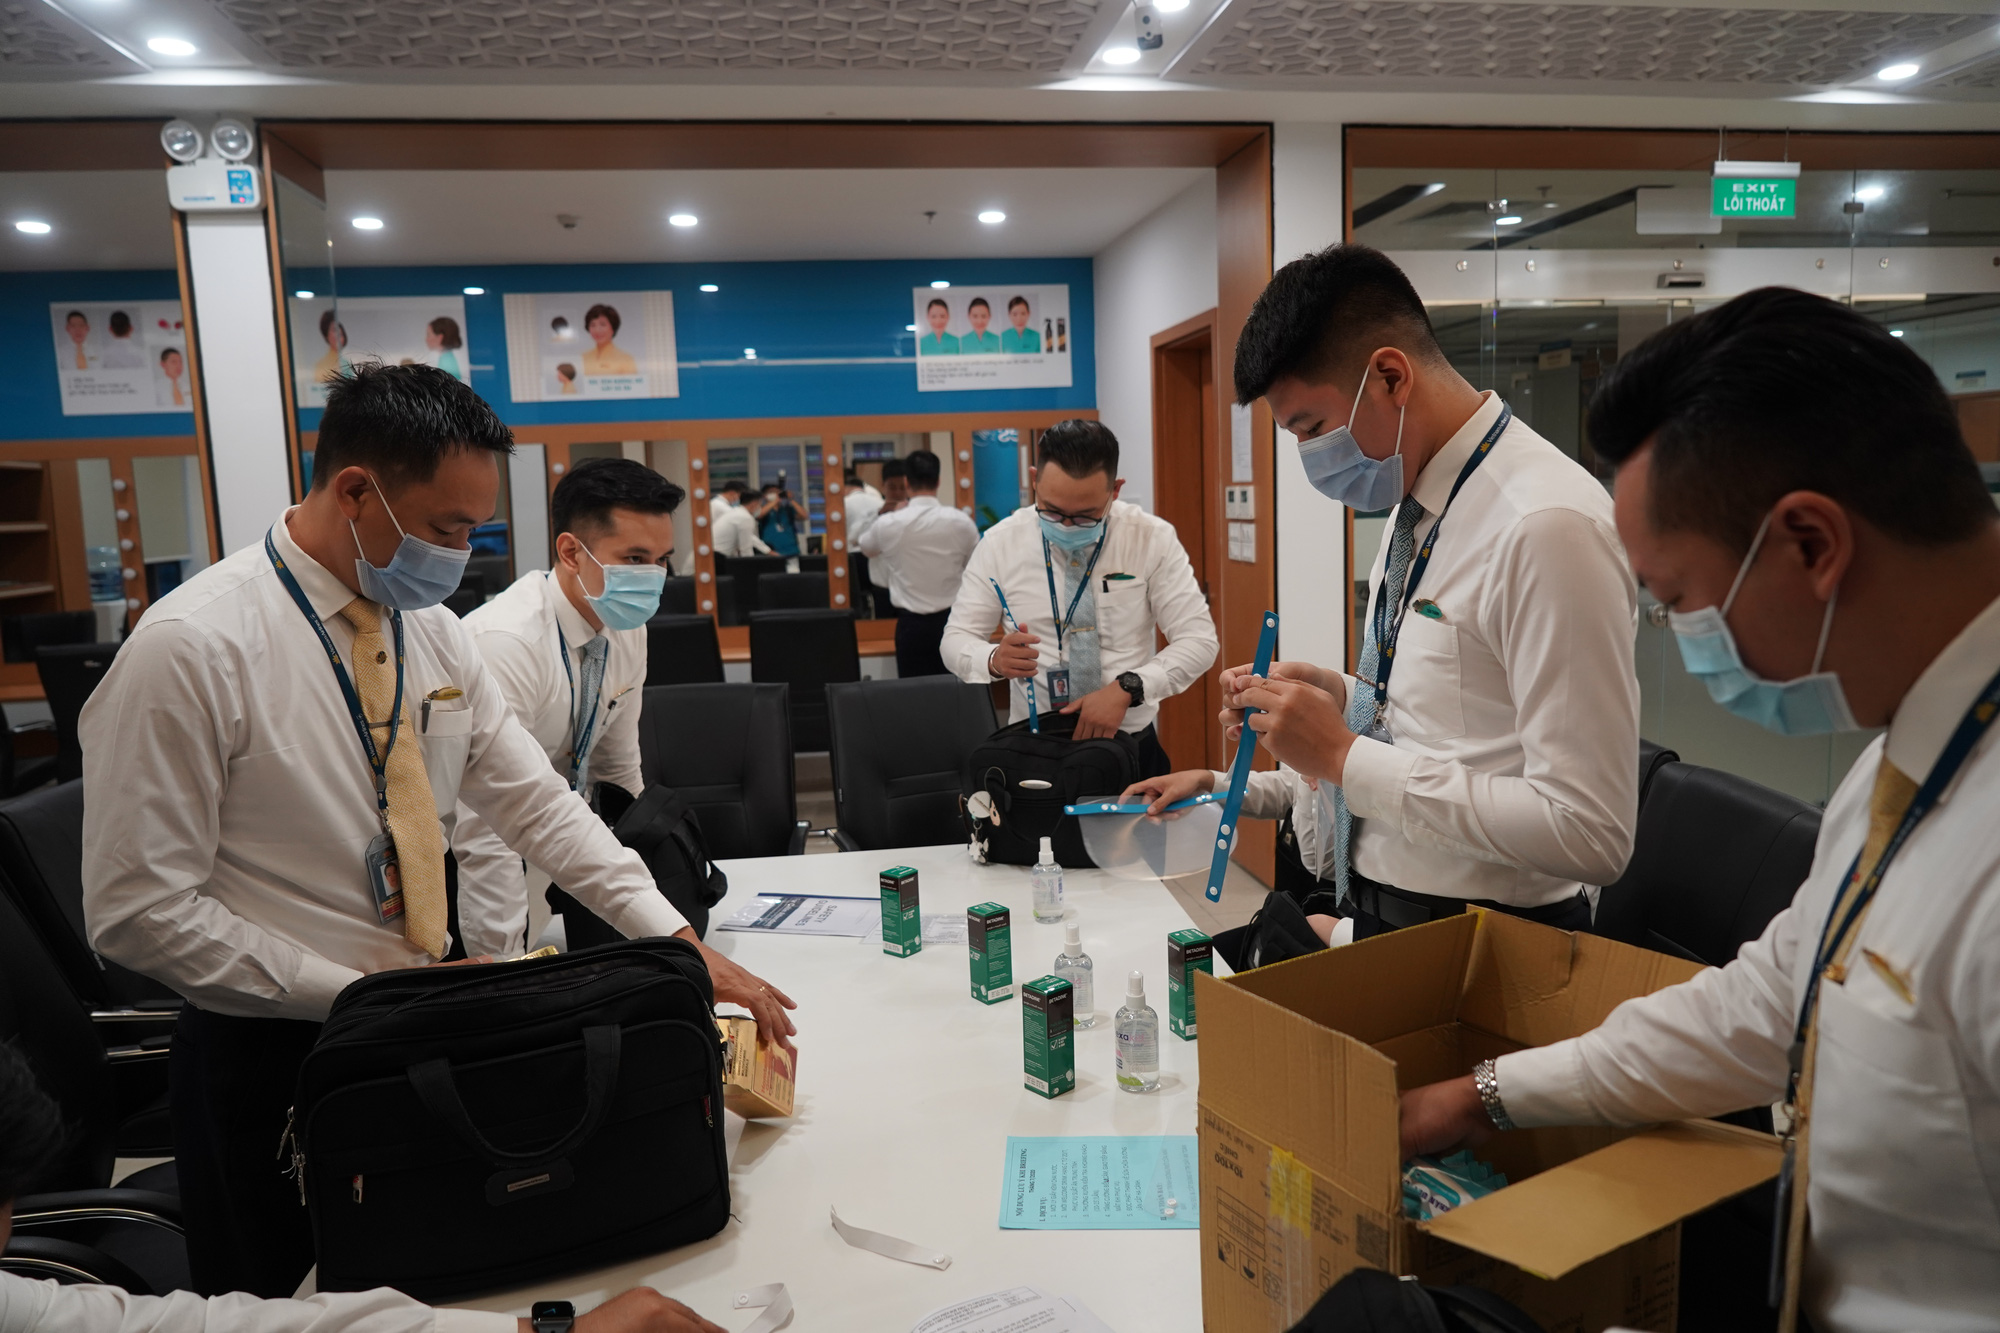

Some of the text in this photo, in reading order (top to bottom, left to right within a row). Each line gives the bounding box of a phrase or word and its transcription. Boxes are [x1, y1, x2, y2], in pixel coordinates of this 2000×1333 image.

[1733, 183, 1779, 193] EXIT
[1745, 194, 1786, 211] THOÁT
[795, 899, 829, 927] GUIDELINES
[814, 904, 838, 924] SAFETY
[986, 915, 1005, 925] BETADINE
[1186, 946, 1206, 955] BETADINE
[1023, 991, 1042, 1003] BETADINE
[1048, 992, 1068, 1005] BETADINE
[1214, 1152, 1244, 1179] 10x100
[1016, 1208, 1024, 1216] NỘI
[1039, 1206, 1047, 1217] DỊCH
